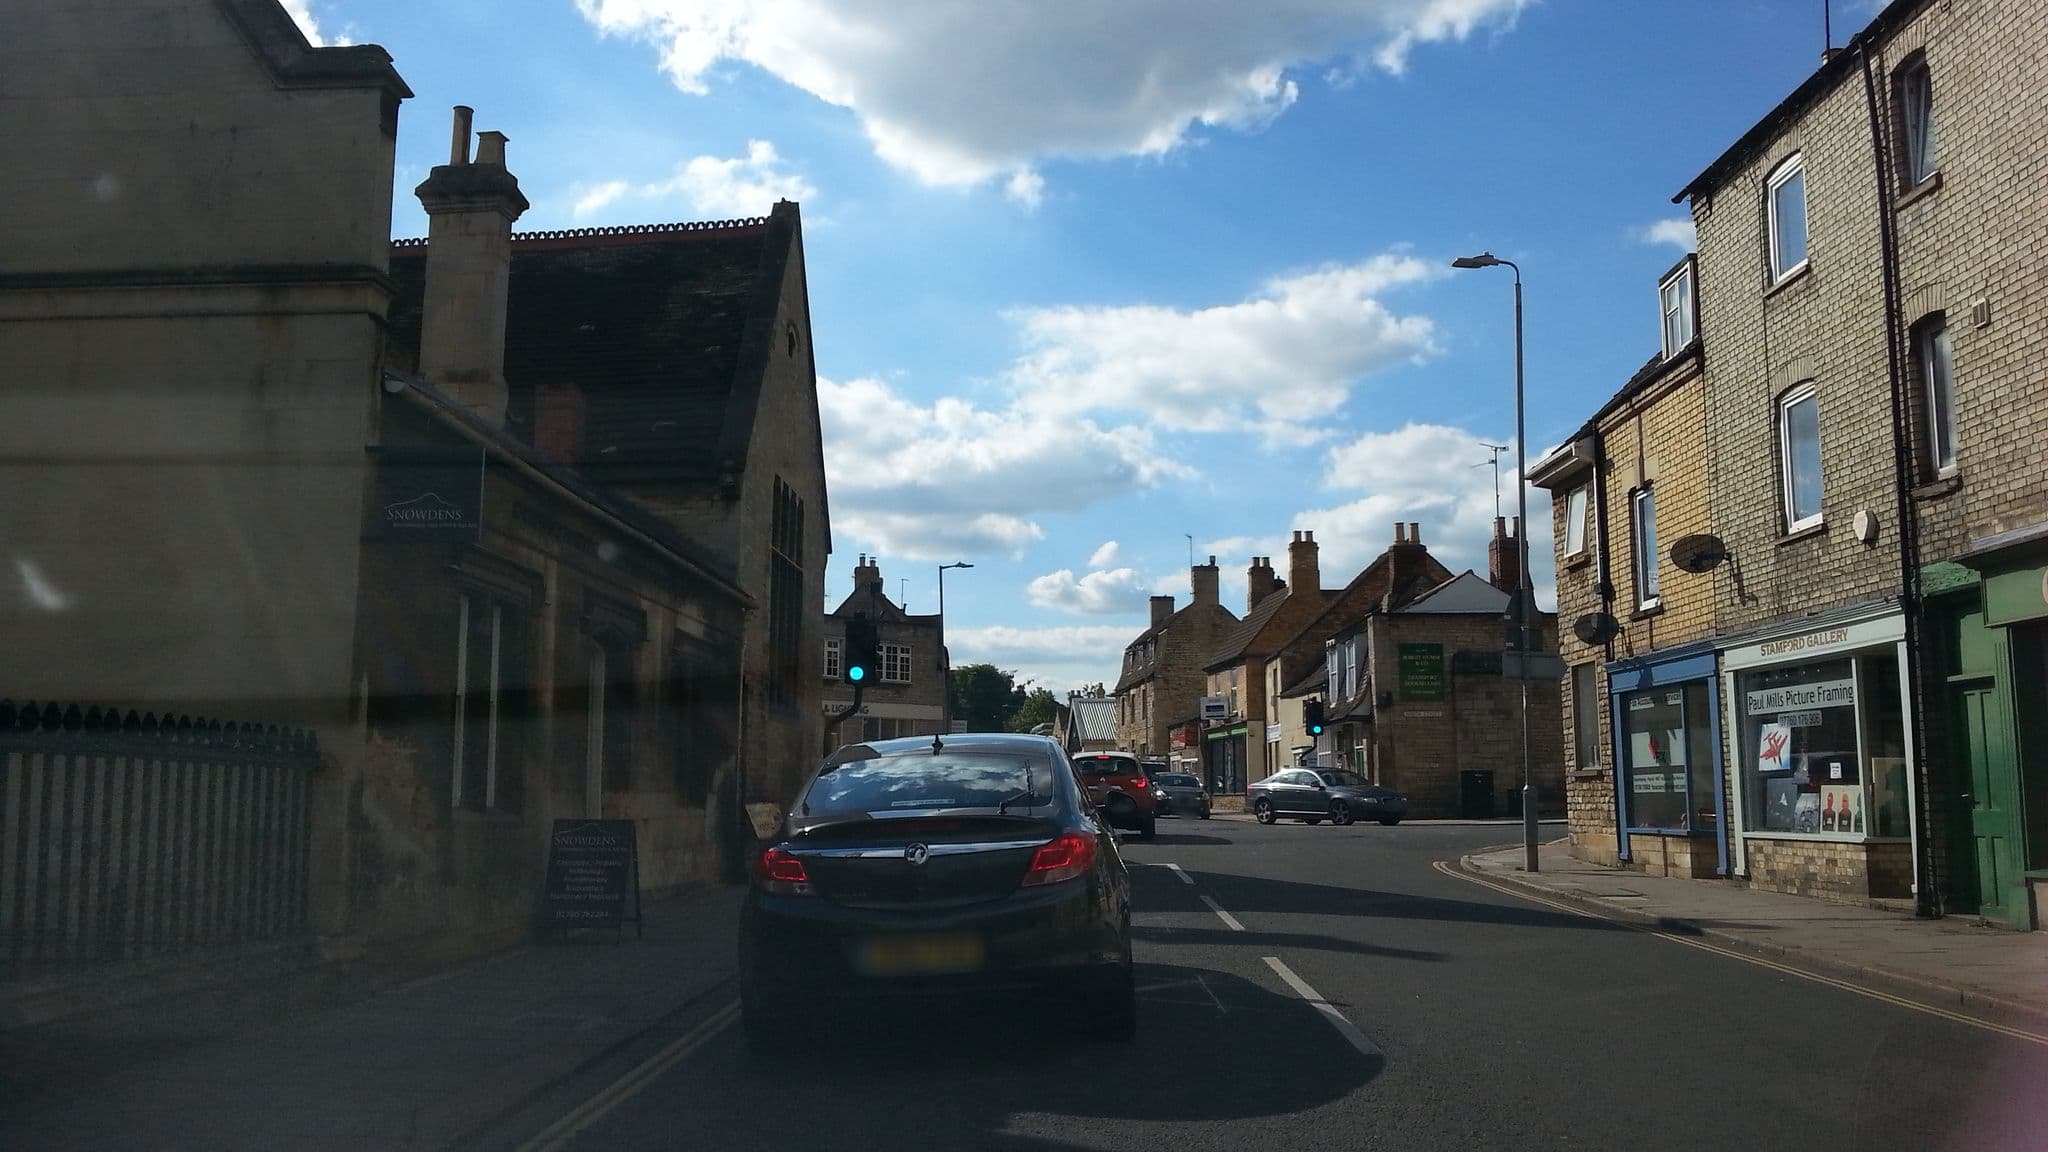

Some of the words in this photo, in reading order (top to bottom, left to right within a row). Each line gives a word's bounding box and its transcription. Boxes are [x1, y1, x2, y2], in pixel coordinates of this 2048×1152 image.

[387, 509, 463, 520] SNOWDENS
[1761, 638, 1805, 657] STAMFORD
[1807, 628, 1849, 648] GALLERY
[1749, 694, 1764, 710] Paul
[1767, 692, 1784, 708] Mills
[1786, 689, 1815, 706] Picture
[1818, 684, 1854, 704] Framing
[553, 836, 616, 846] SNOWDENS
